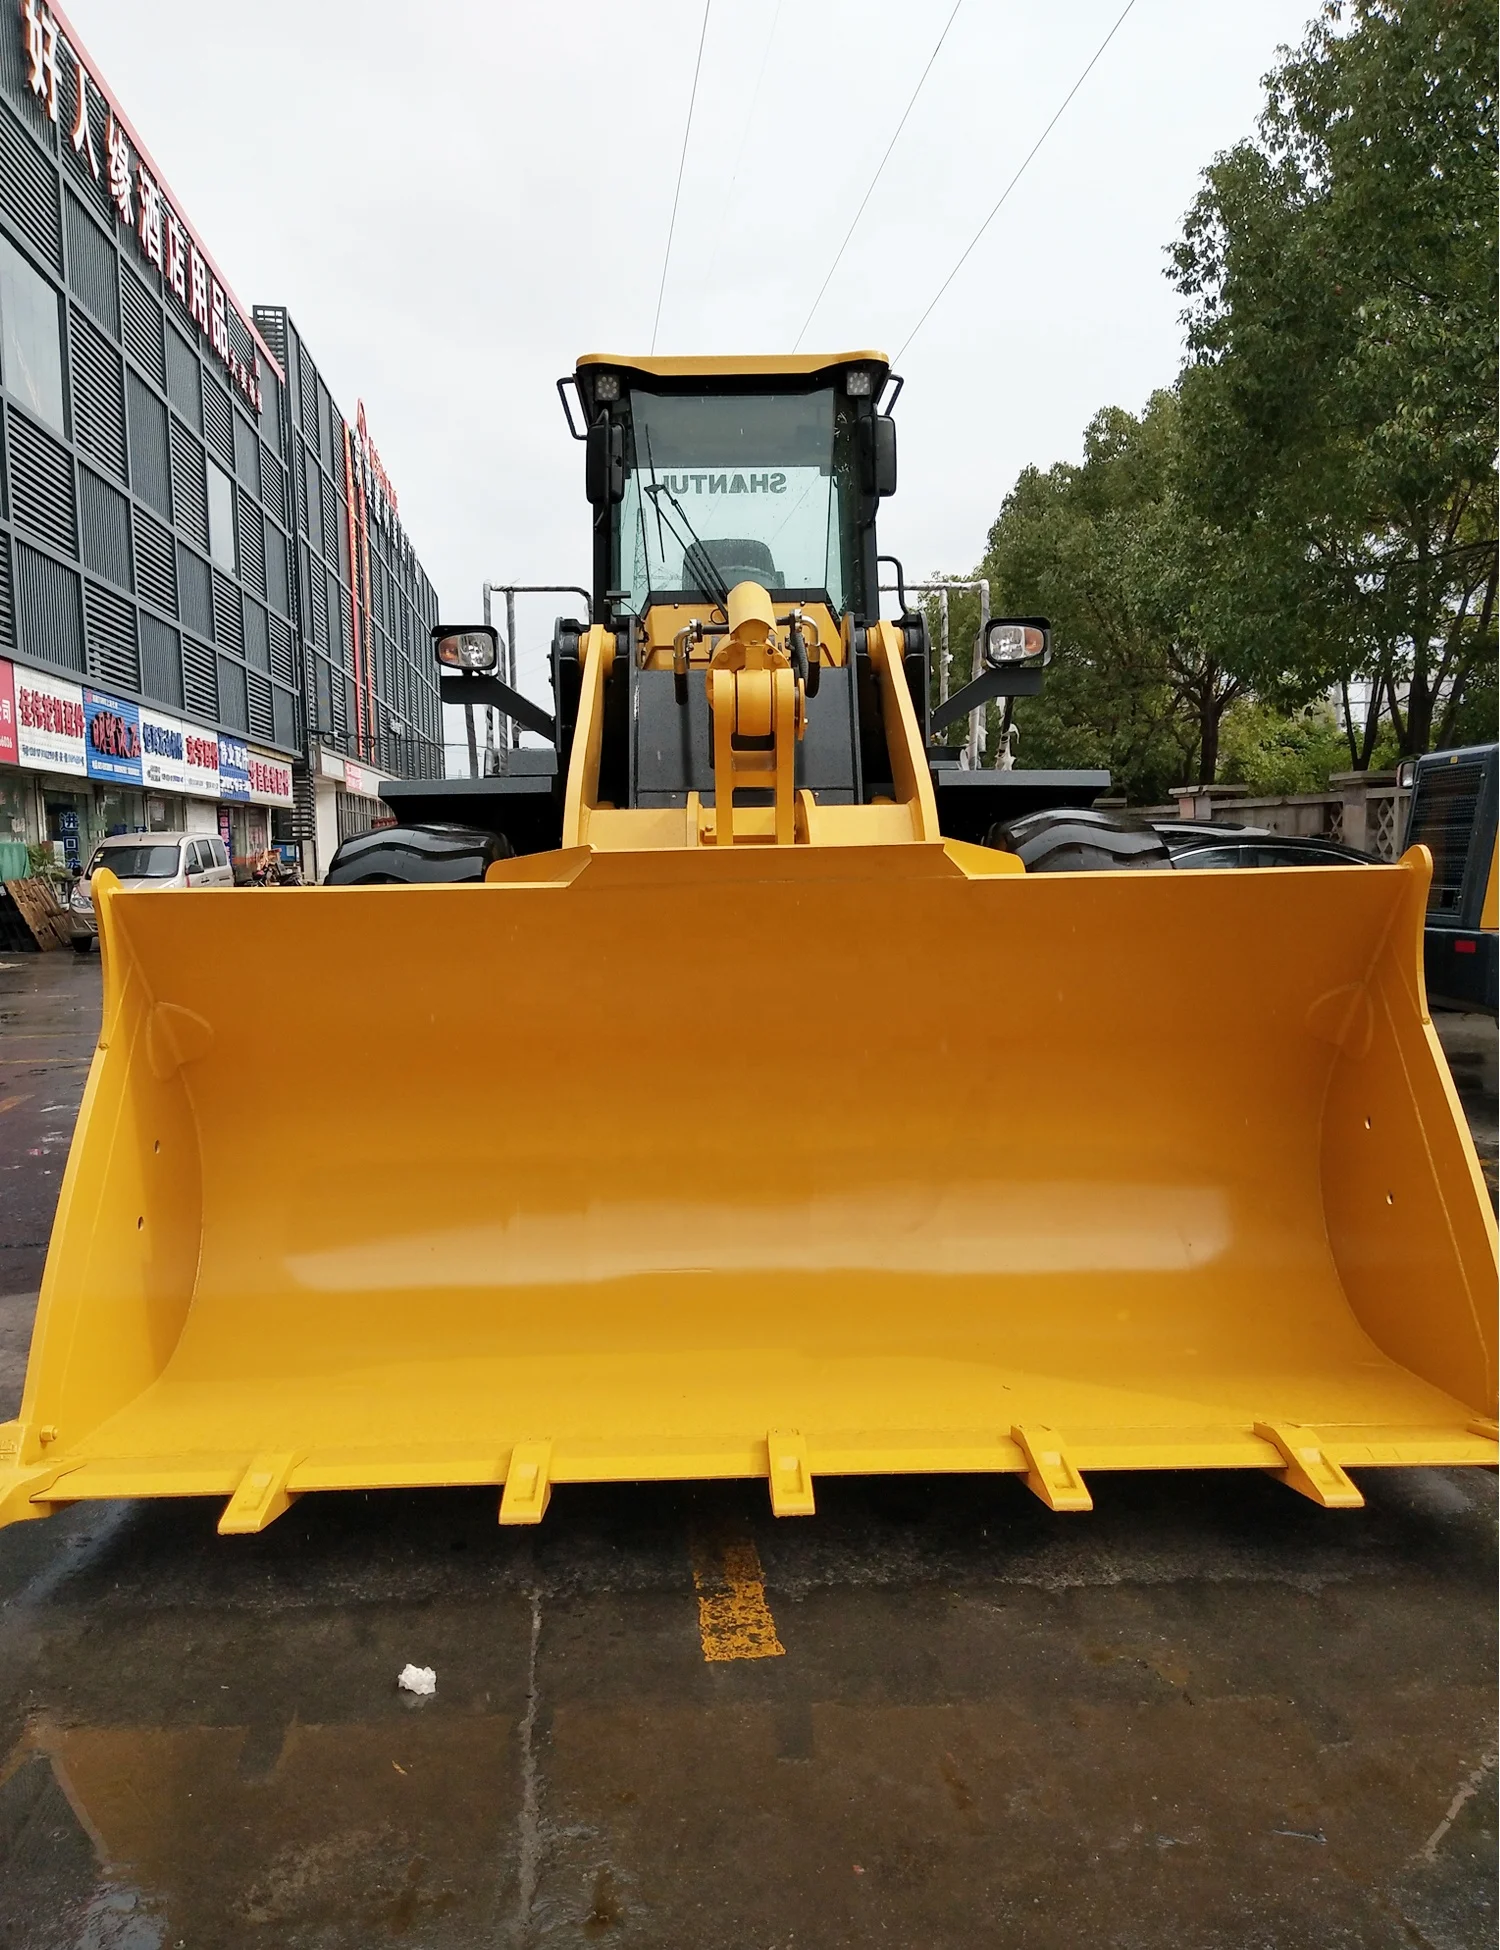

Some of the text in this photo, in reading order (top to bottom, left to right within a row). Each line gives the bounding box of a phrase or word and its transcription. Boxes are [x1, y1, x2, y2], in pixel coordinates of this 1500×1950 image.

[21, 0, 231, 365] 好人缘酒店用品
